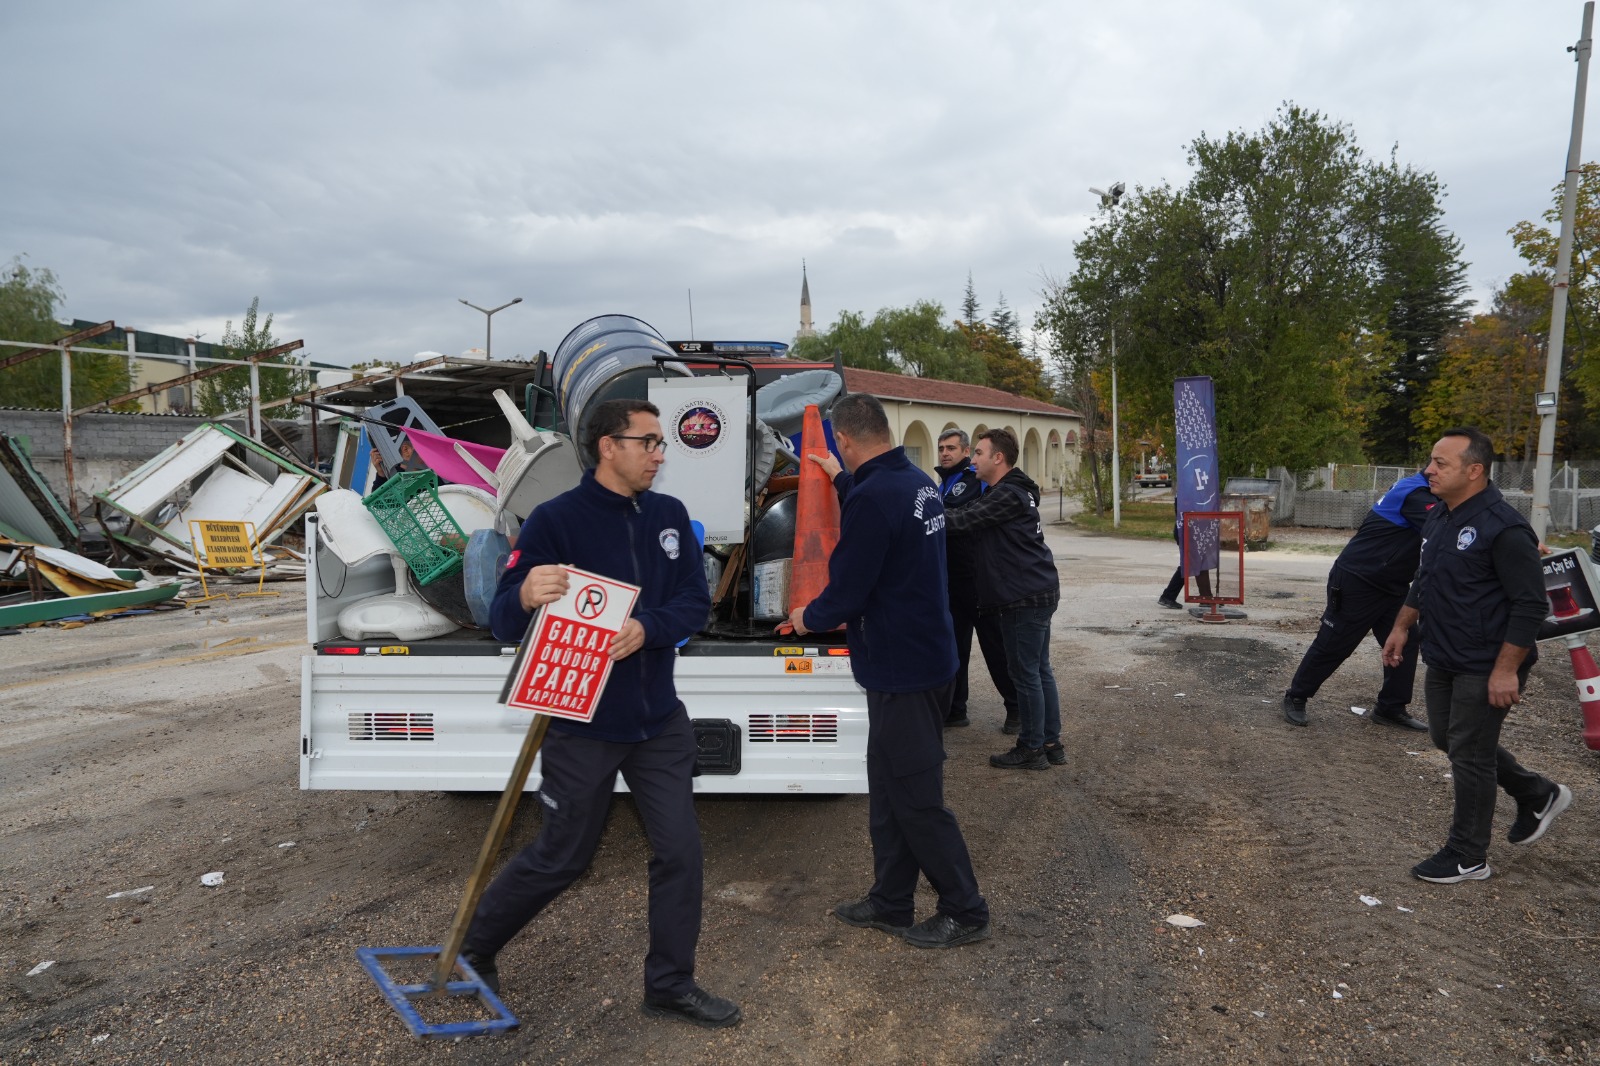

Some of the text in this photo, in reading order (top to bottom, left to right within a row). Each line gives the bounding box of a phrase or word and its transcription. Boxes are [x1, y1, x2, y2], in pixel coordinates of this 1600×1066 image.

[206, 523, 240, 532] BÜYÜKŞEHİR
[210, 534, 240, 542] BELEDİYESİ
[1551, 561, 1565, 575] Çay
[1562, 557, 1575, 569] Evi
[548, 620, 611, 652] GARAJ
[540, 642, 601, 672] ÖNÜDÜR
[529, 662, 596, 697] PARK
[525, 688, 587, 710] YAPILMAZ
